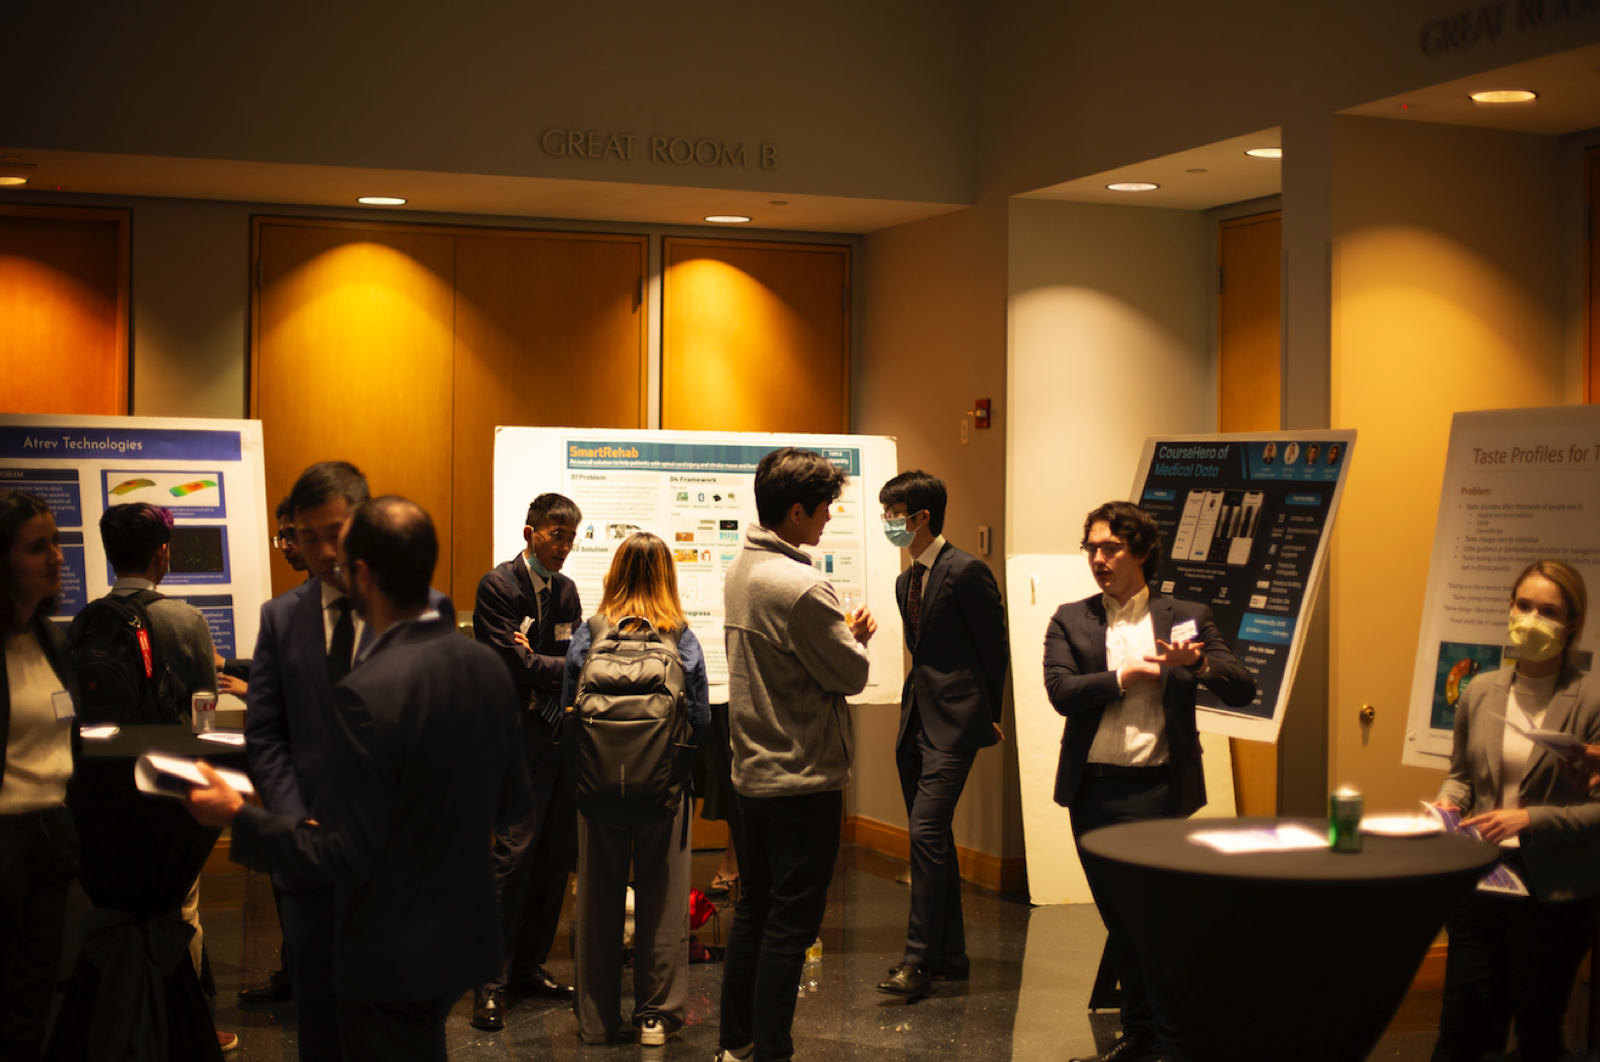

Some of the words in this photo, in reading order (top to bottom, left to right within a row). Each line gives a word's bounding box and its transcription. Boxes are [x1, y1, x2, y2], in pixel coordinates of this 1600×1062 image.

[1419, 4, 1504, 57] GREAT
[541, 129, 639, 160] GREAT
[651, 136, 750, 168] ROOM
[762, 145, 779, 169] B
[23, 436, 58, 449] Atrev
[62, 436, 143, 452] Technologies
[570, 446, 639, 458] SmartRehab
[1158, 446, 1216, 459] CourseHero
[1217, 445, 1230, 459] of
[1474, 448, 1508, 464] Taste
[1510, 445, 1564, 463] Profiles
[1568, 444, 1590, 462] for
[1154, 463, 1194, 476] Medical
[1194, 464, 1220, 477] Data
